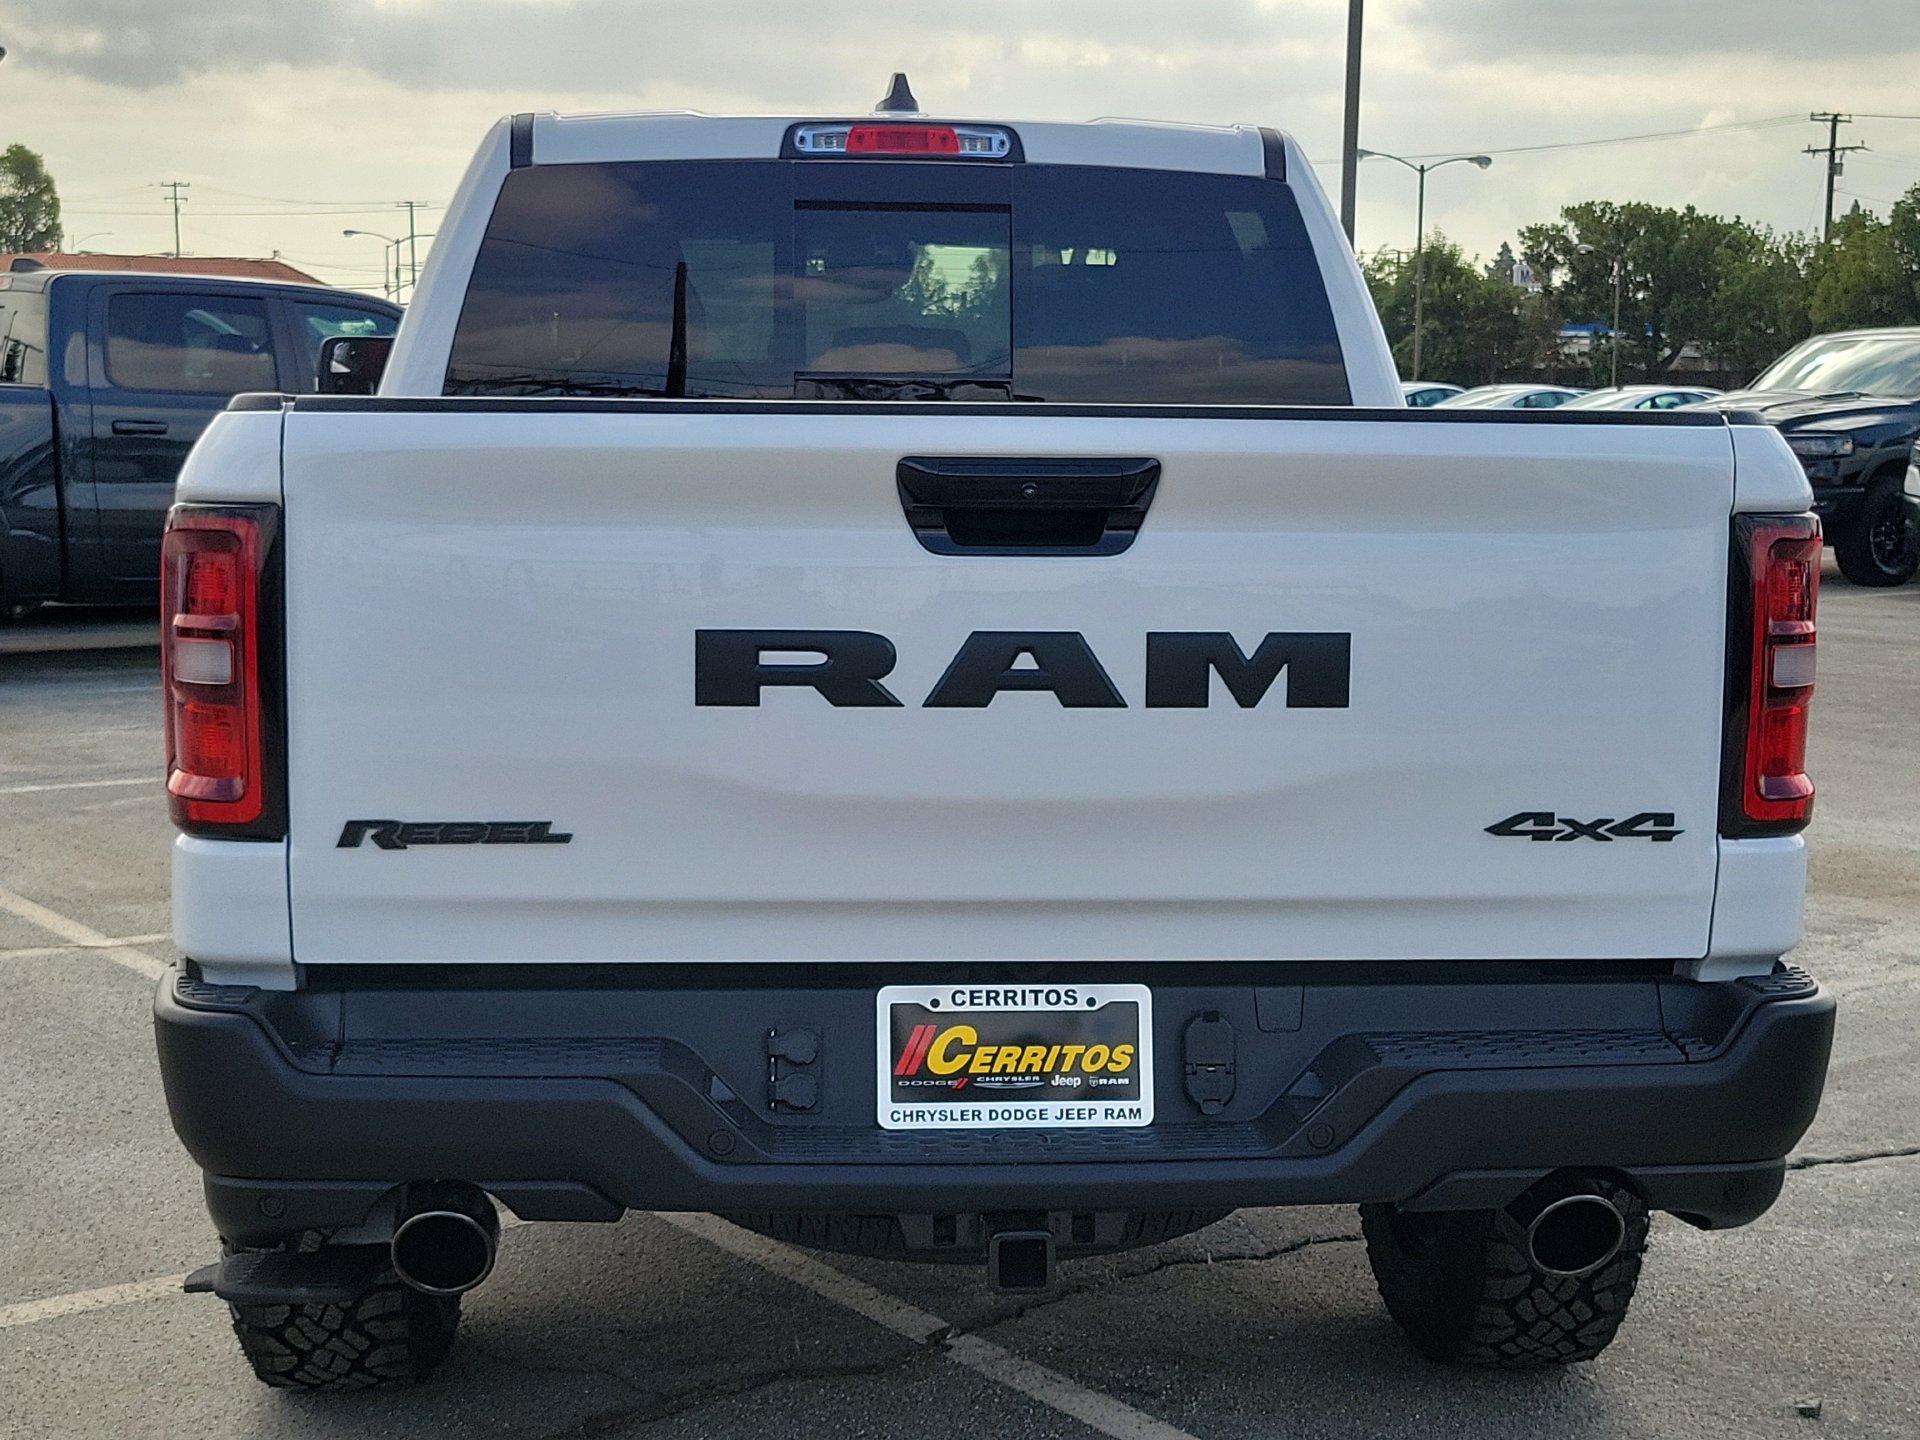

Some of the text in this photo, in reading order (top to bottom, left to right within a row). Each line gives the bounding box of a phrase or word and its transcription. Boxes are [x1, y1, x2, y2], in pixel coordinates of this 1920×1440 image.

[694, 629, 1352, 708] RAM
[336, 819, 573, 850] REBEL
[1483, 811, 1685, 842] 4x4
[951, 989, 1078, 1007] CERRITOS
[1051, 1074, 1082, 1088] Jeep
[890, 1107, 1143, 1123] CHRYSLER DODGE JEEP RAM
